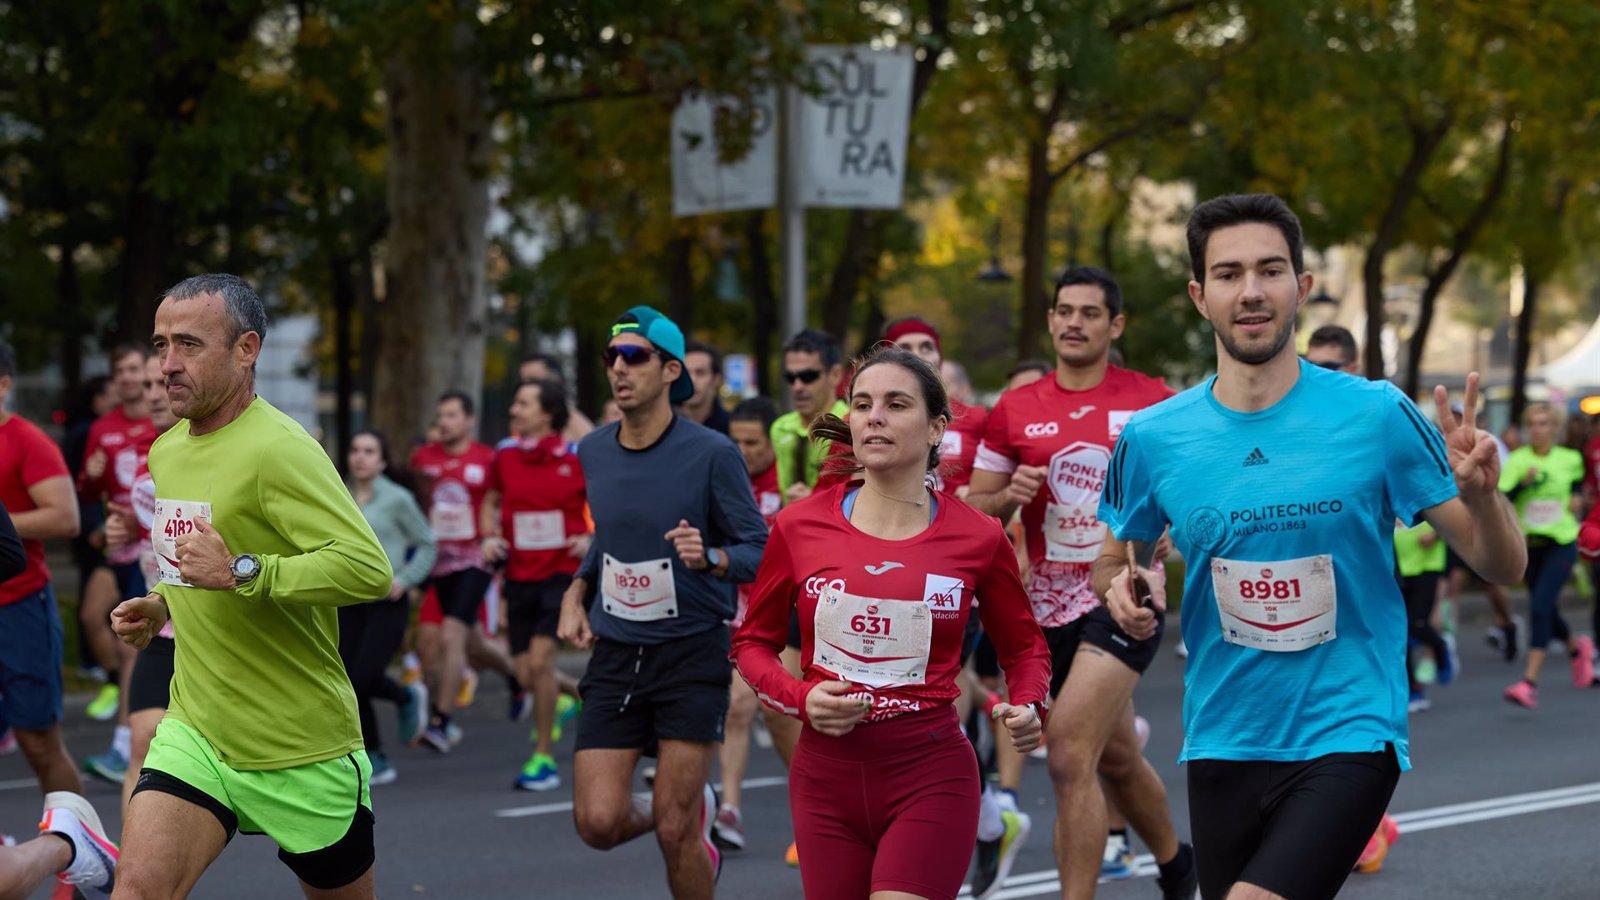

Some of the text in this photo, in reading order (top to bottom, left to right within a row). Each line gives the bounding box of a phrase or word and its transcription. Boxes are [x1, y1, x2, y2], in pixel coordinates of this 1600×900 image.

[822, 99, 874, 137] TU
[840, 141, 895, 176] RA
[1060, 461, 1107, 480] PONLE
[1057, 474, 1104, 492] FRENO
[1058, 514, 1100, 529] 2342
[1230, 500, 1343, 524] POLITECNICO
[1233, 520, 1307, 538] MILANO 1863
[614, 573, 651, 588] 1820
[1239, 579, 1301, 599] 8981
[851, 615, 892, 636] 631
[932, 612, 959, 620] ndación
